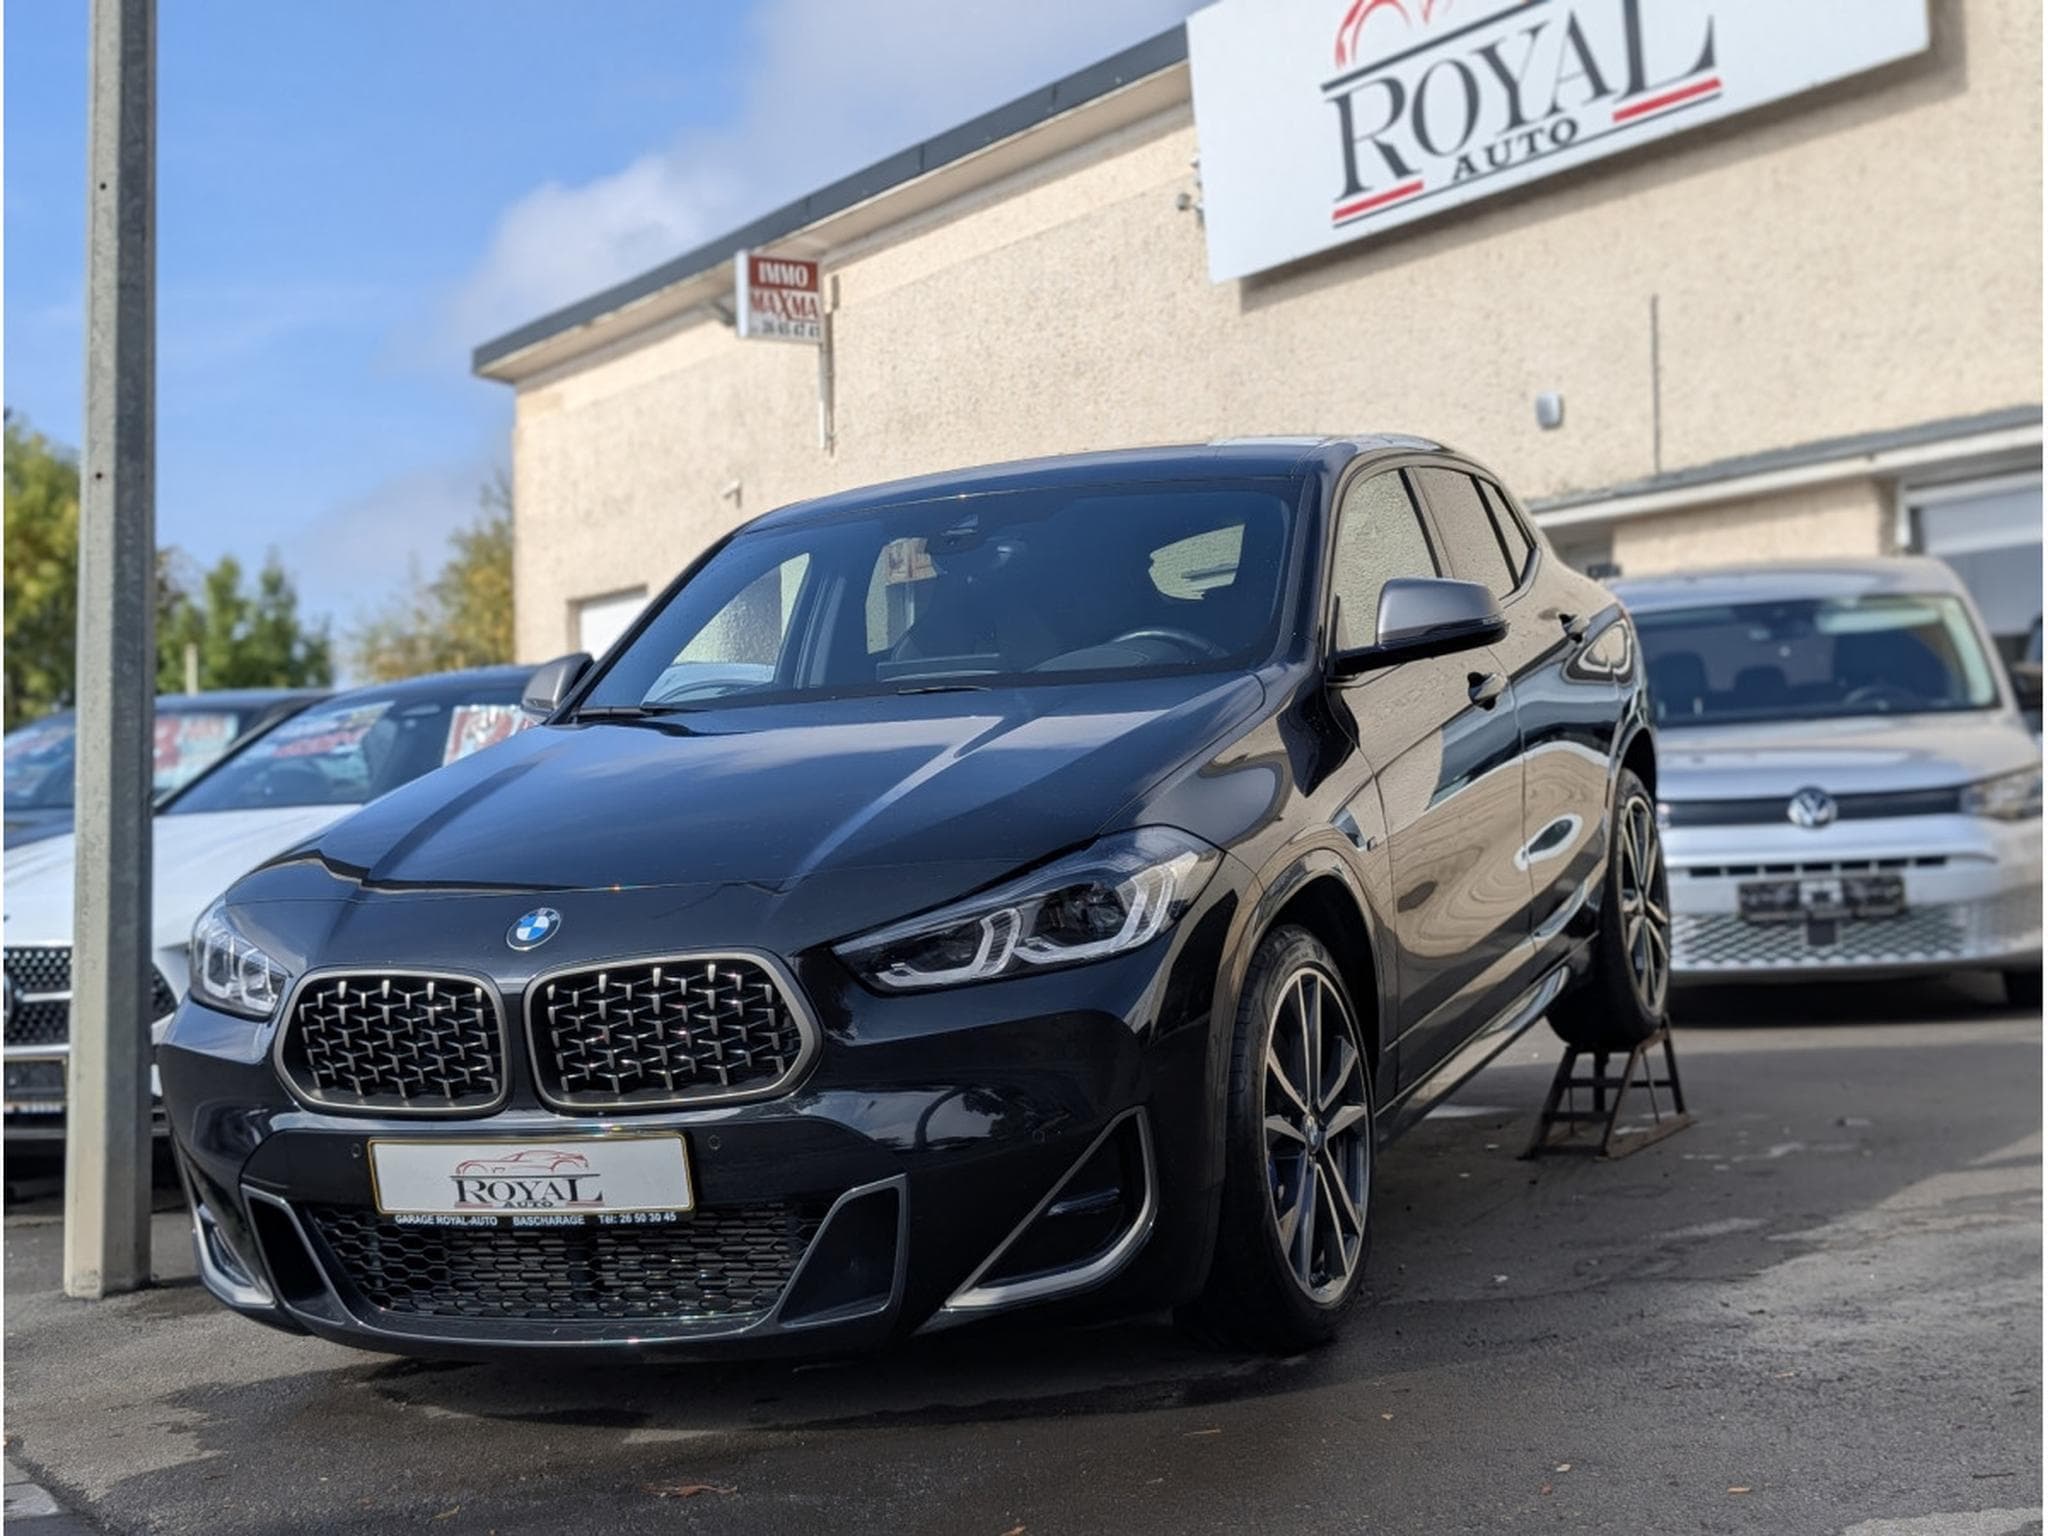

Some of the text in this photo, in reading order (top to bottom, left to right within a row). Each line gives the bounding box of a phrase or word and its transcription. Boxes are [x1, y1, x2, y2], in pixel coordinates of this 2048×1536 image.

[1326, 0, 1716, 203] ROYAL
[1452, 117, 1579, 182] AUTO
[758, 260, 809, 288] IMMO
[452, 1178, 604, 1203] ROYAL
[503, 1200, 554, 1209] AUTO
[394, 1214, 434, 1225] GARAGE
[435, 1215, 498, 1227] ROYAL-AUTO
[512, 1214, 585, 1227] BASCHARAGE
[619, 1213, 632, 1224] 26
[634, 1212, 647, 1223] 50
[649, 1211, 662, 1223] 30
[663, 1210, 677, 1222] 45
